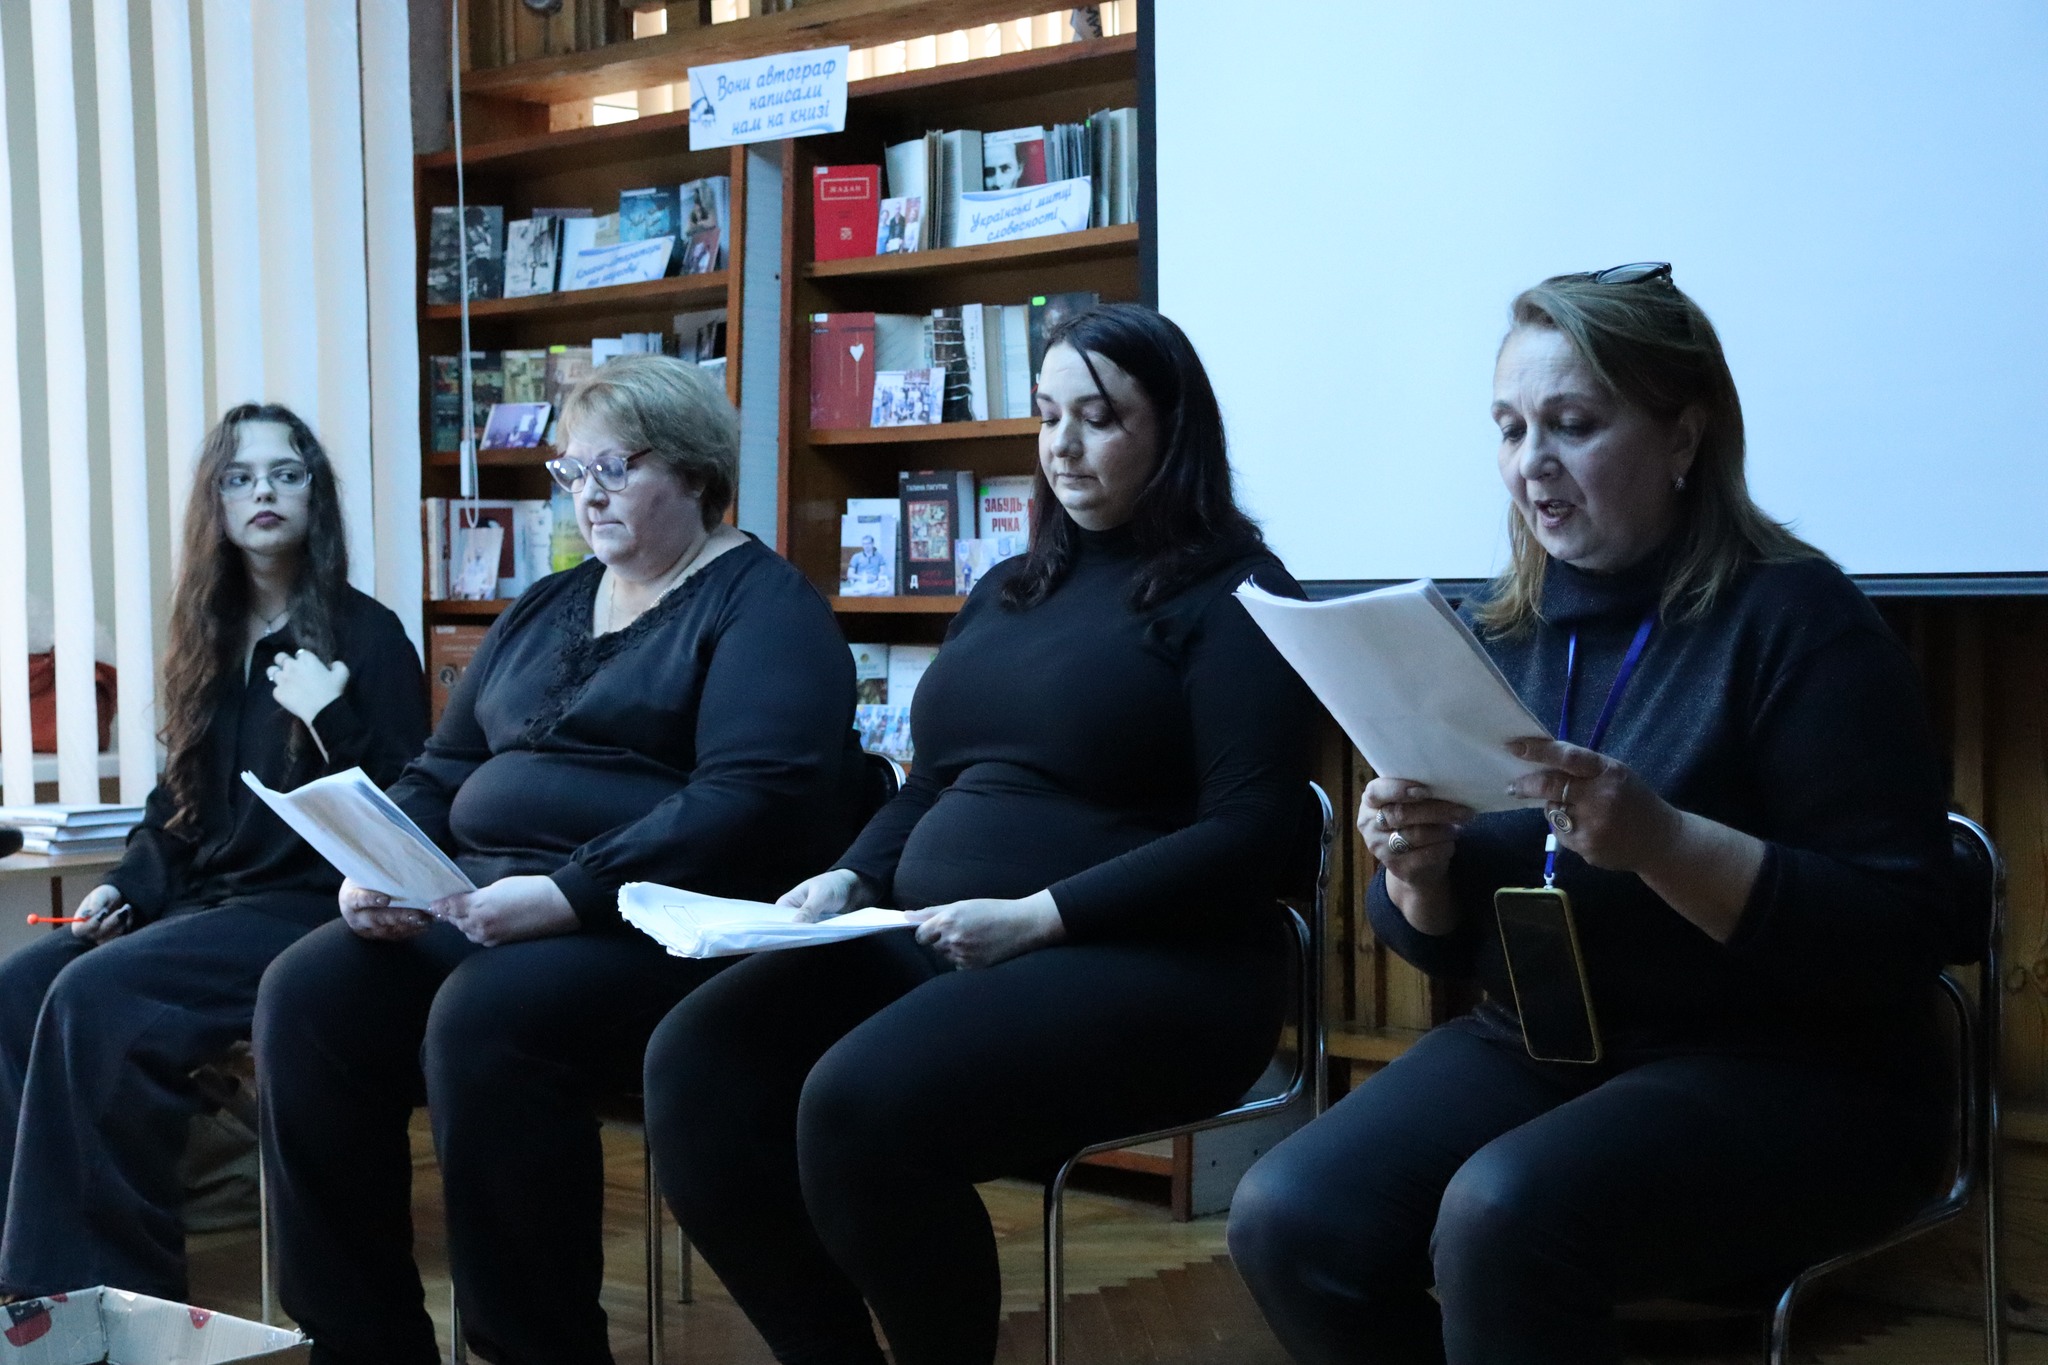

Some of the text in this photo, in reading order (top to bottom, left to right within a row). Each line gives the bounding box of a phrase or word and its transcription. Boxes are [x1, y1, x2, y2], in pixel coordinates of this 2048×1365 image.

[717, 59, 837, 102] Вони автограф
[749, 84, 823, 111] написали
[731, 100, 830, 136] нам на книзі
[830, 185, 862, 194] ЖАДАН
[970, 183, 1072, 233] Українські митці
[987, 207, 1059, 242] словесності
[991, 517, 1021, 533] РІЧКА
